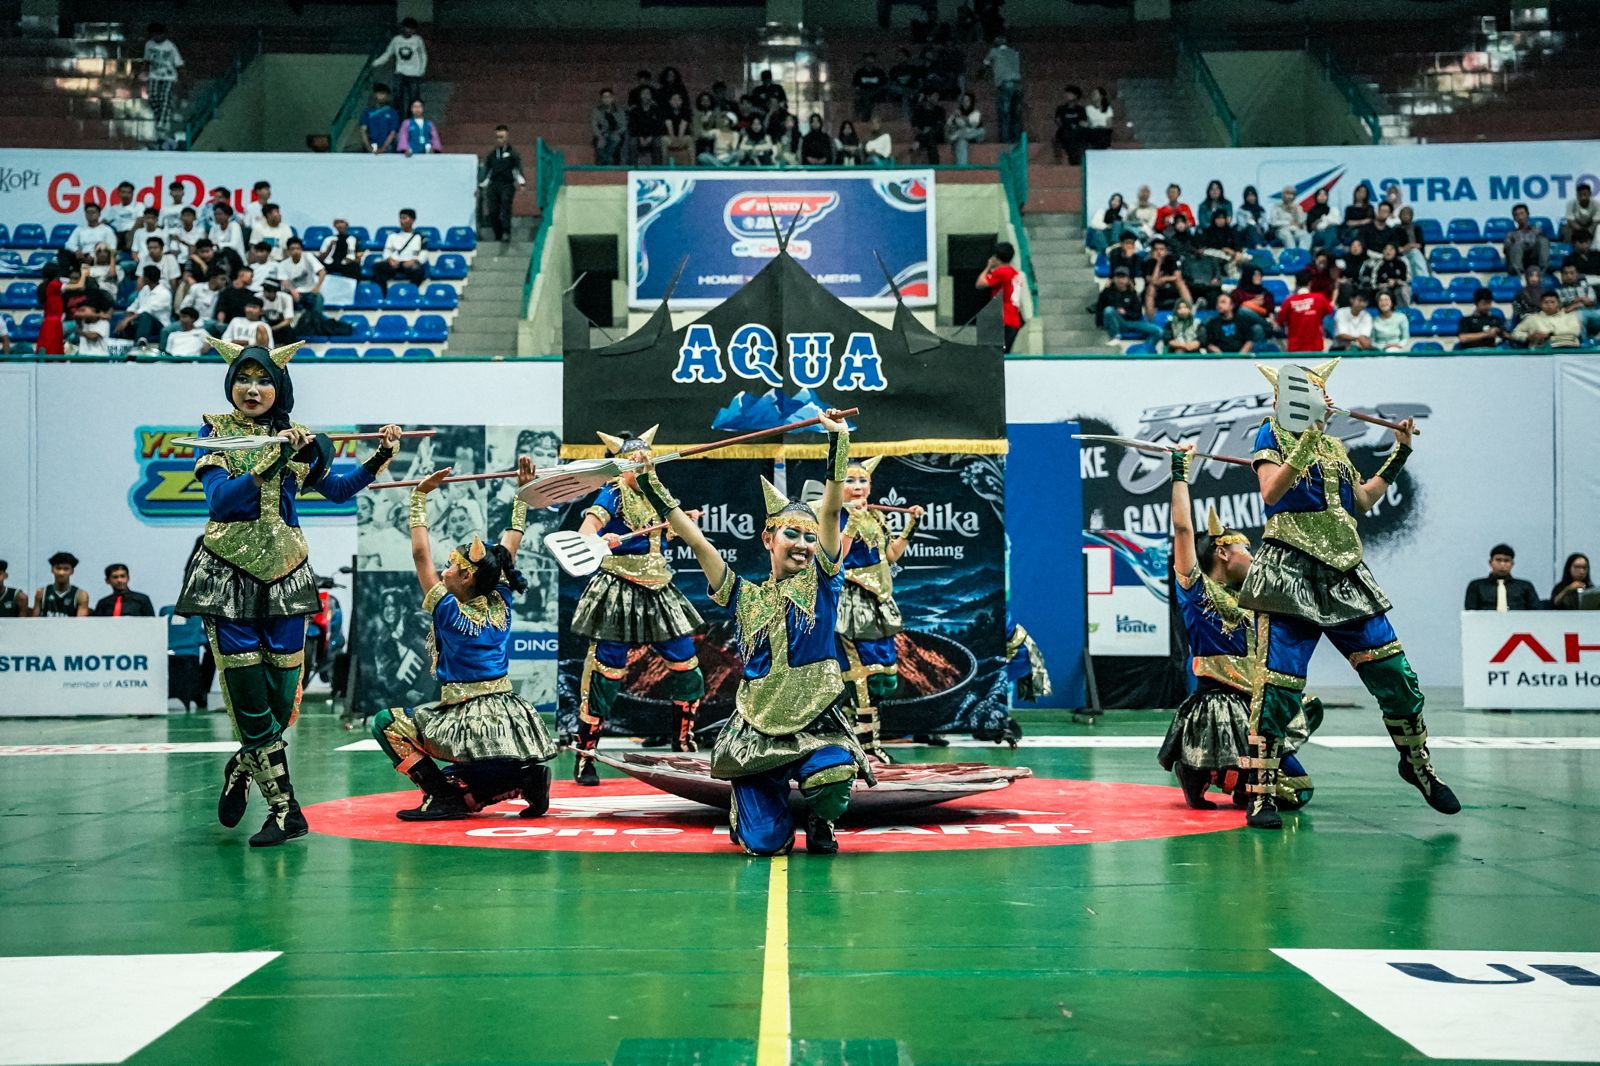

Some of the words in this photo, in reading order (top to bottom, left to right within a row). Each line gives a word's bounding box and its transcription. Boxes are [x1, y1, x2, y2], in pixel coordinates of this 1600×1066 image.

[1359, 177, 1477, 202] ASTRA
[1489, 174, 1600, 200] MOTO
[672, 323, 888, 392] AQUA
[1080, 446, 1109, 479] KE
[1123, 501, 1182, 537] GAY
[904, 543, 964, 560] Minang
[1489, 633, 1600, 663] AH
[0, 655, 57, 672] STRA
[64, 655, 148, 671] MOTOR
[103, 680, 113, 688] of
[115, 680, 148, 688] ASTRA
[1487, 671, 1510, 686] PT
[1517, 671, 1568, 687] Astra
[1575, 671, 1600, 687] Ho
[465, 826, 684, 836] One
